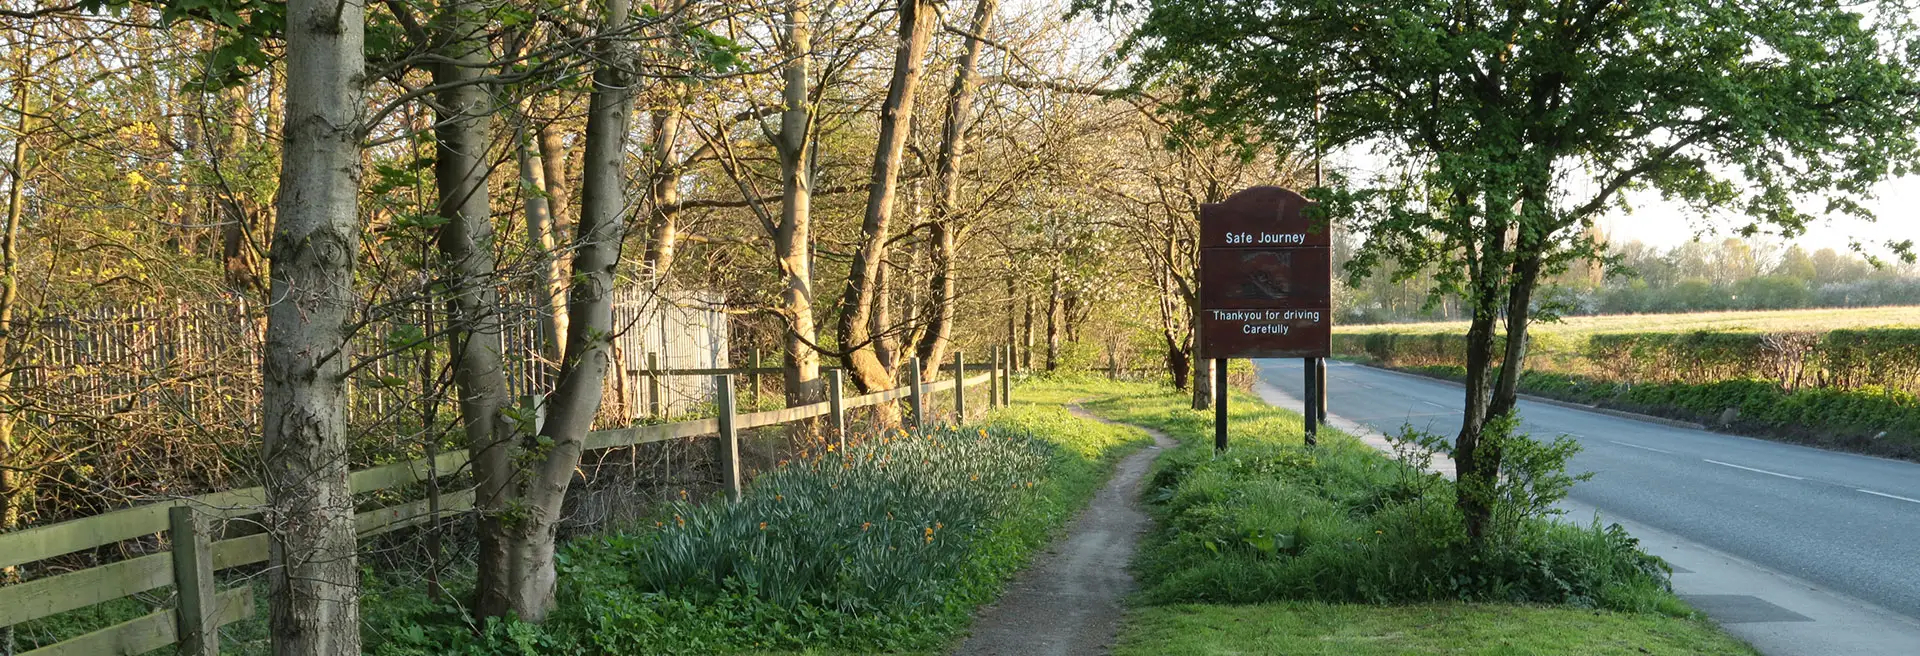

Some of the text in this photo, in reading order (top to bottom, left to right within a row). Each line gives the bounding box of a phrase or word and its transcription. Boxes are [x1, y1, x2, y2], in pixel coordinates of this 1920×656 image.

[1225, 232, 1306, 245] Safe Journey
[1213, 310, 1320, 322] Thankyou for driving
[1243, 324, 1289, 335] Carefully
